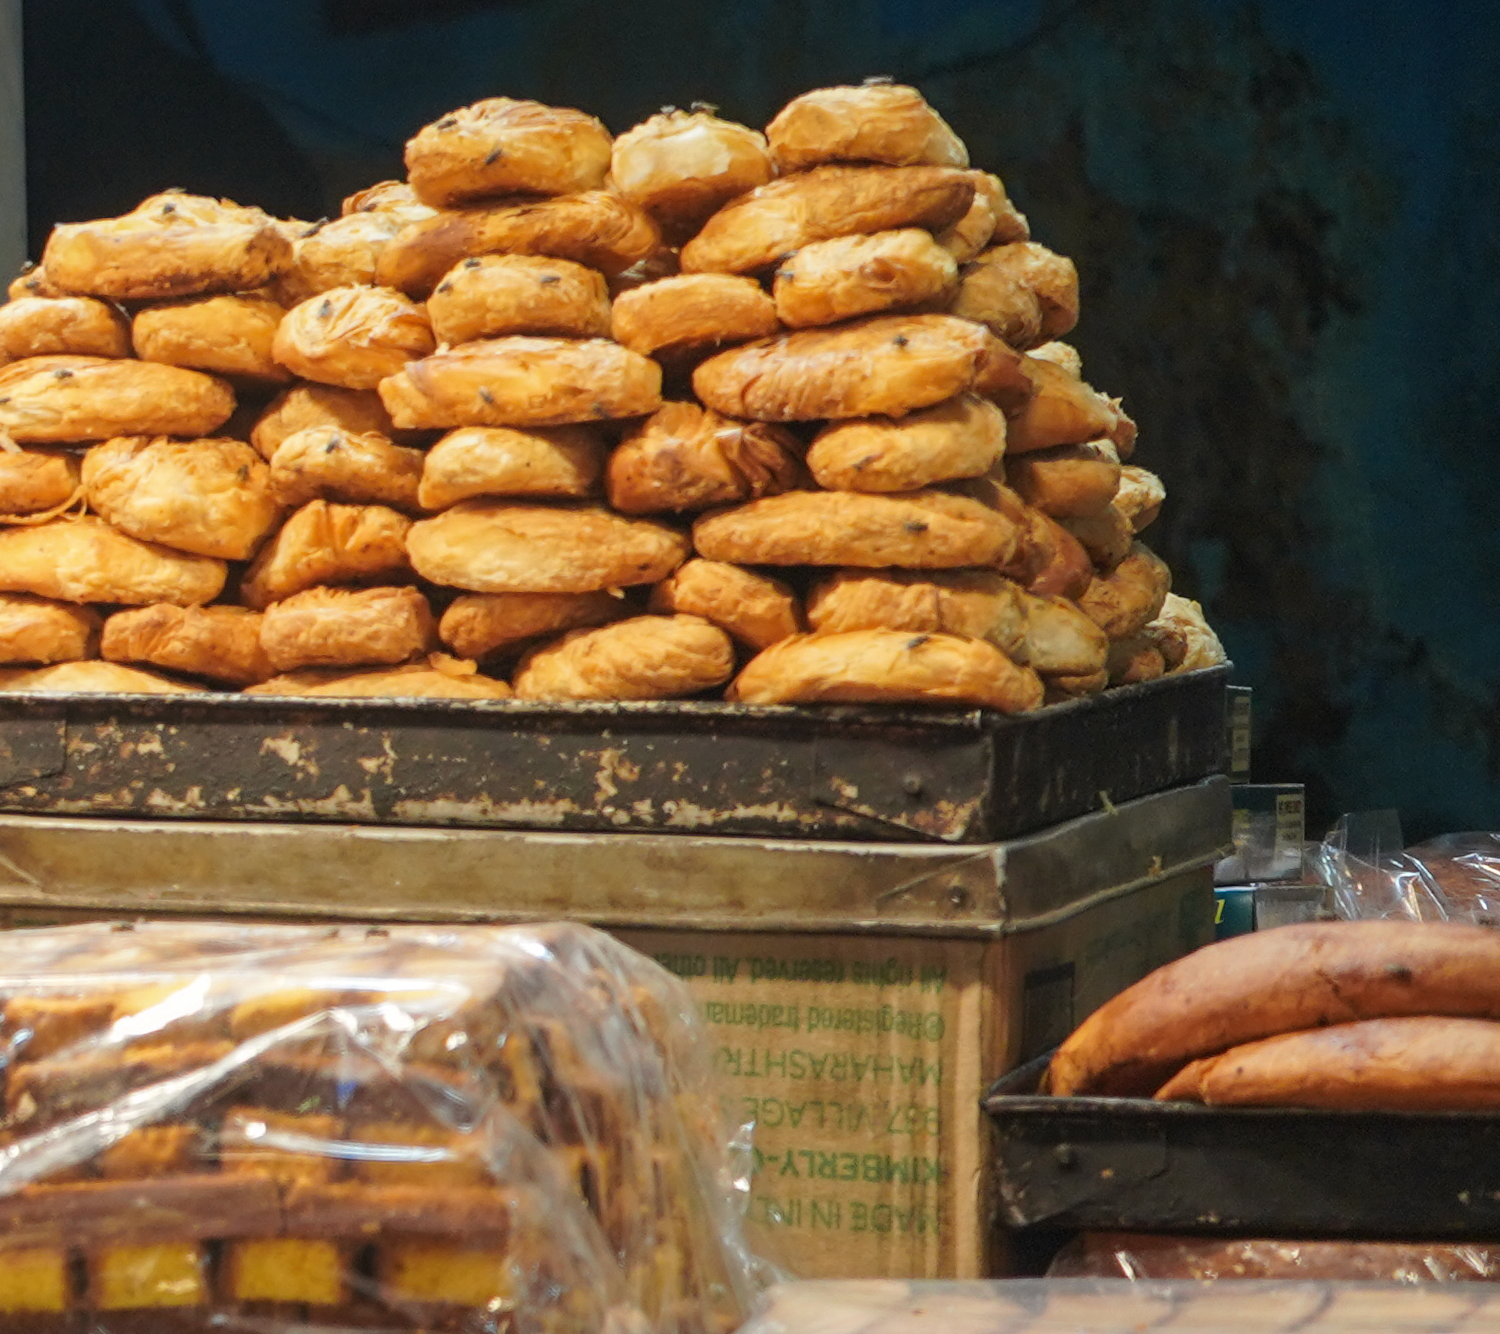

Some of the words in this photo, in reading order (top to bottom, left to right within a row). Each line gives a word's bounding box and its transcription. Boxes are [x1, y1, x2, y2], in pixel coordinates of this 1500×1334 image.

[743, 1096, 871, 1133] VILLAGE
[810, 1199, 841, 1230] IN
[850, 1201, 940, 1234] MADE
